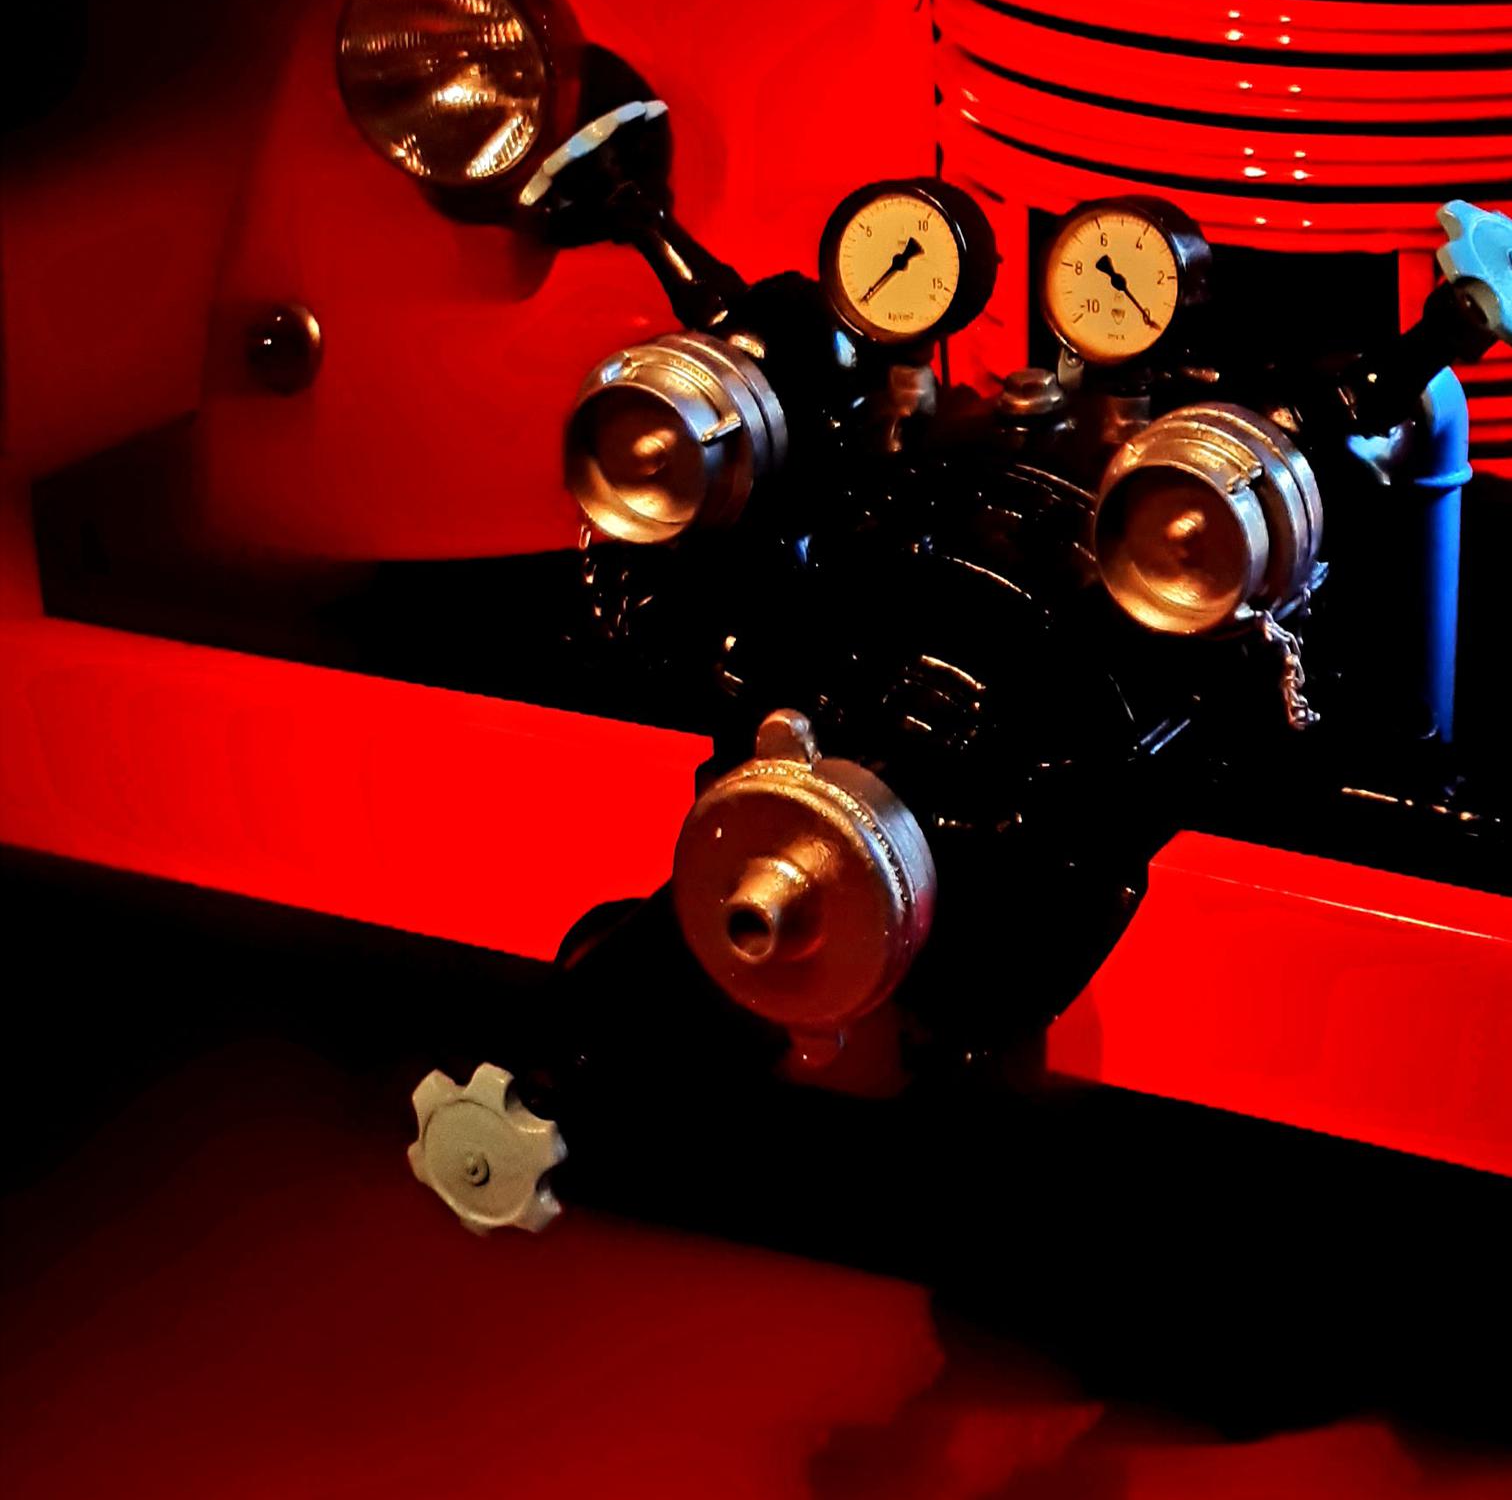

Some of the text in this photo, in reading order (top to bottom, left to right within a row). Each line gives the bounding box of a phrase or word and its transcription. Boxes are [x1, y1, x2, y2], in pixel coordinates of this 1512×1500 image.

[918, 219, 929, 232] 10
[1100, 232, 1108, 247] 6
[1135, 237, 1143, 251] 4
[1074, 261, 1083, 275] 8
[932, 277, 944, 290] 15
[1156, 270, 1165, 285] 2
